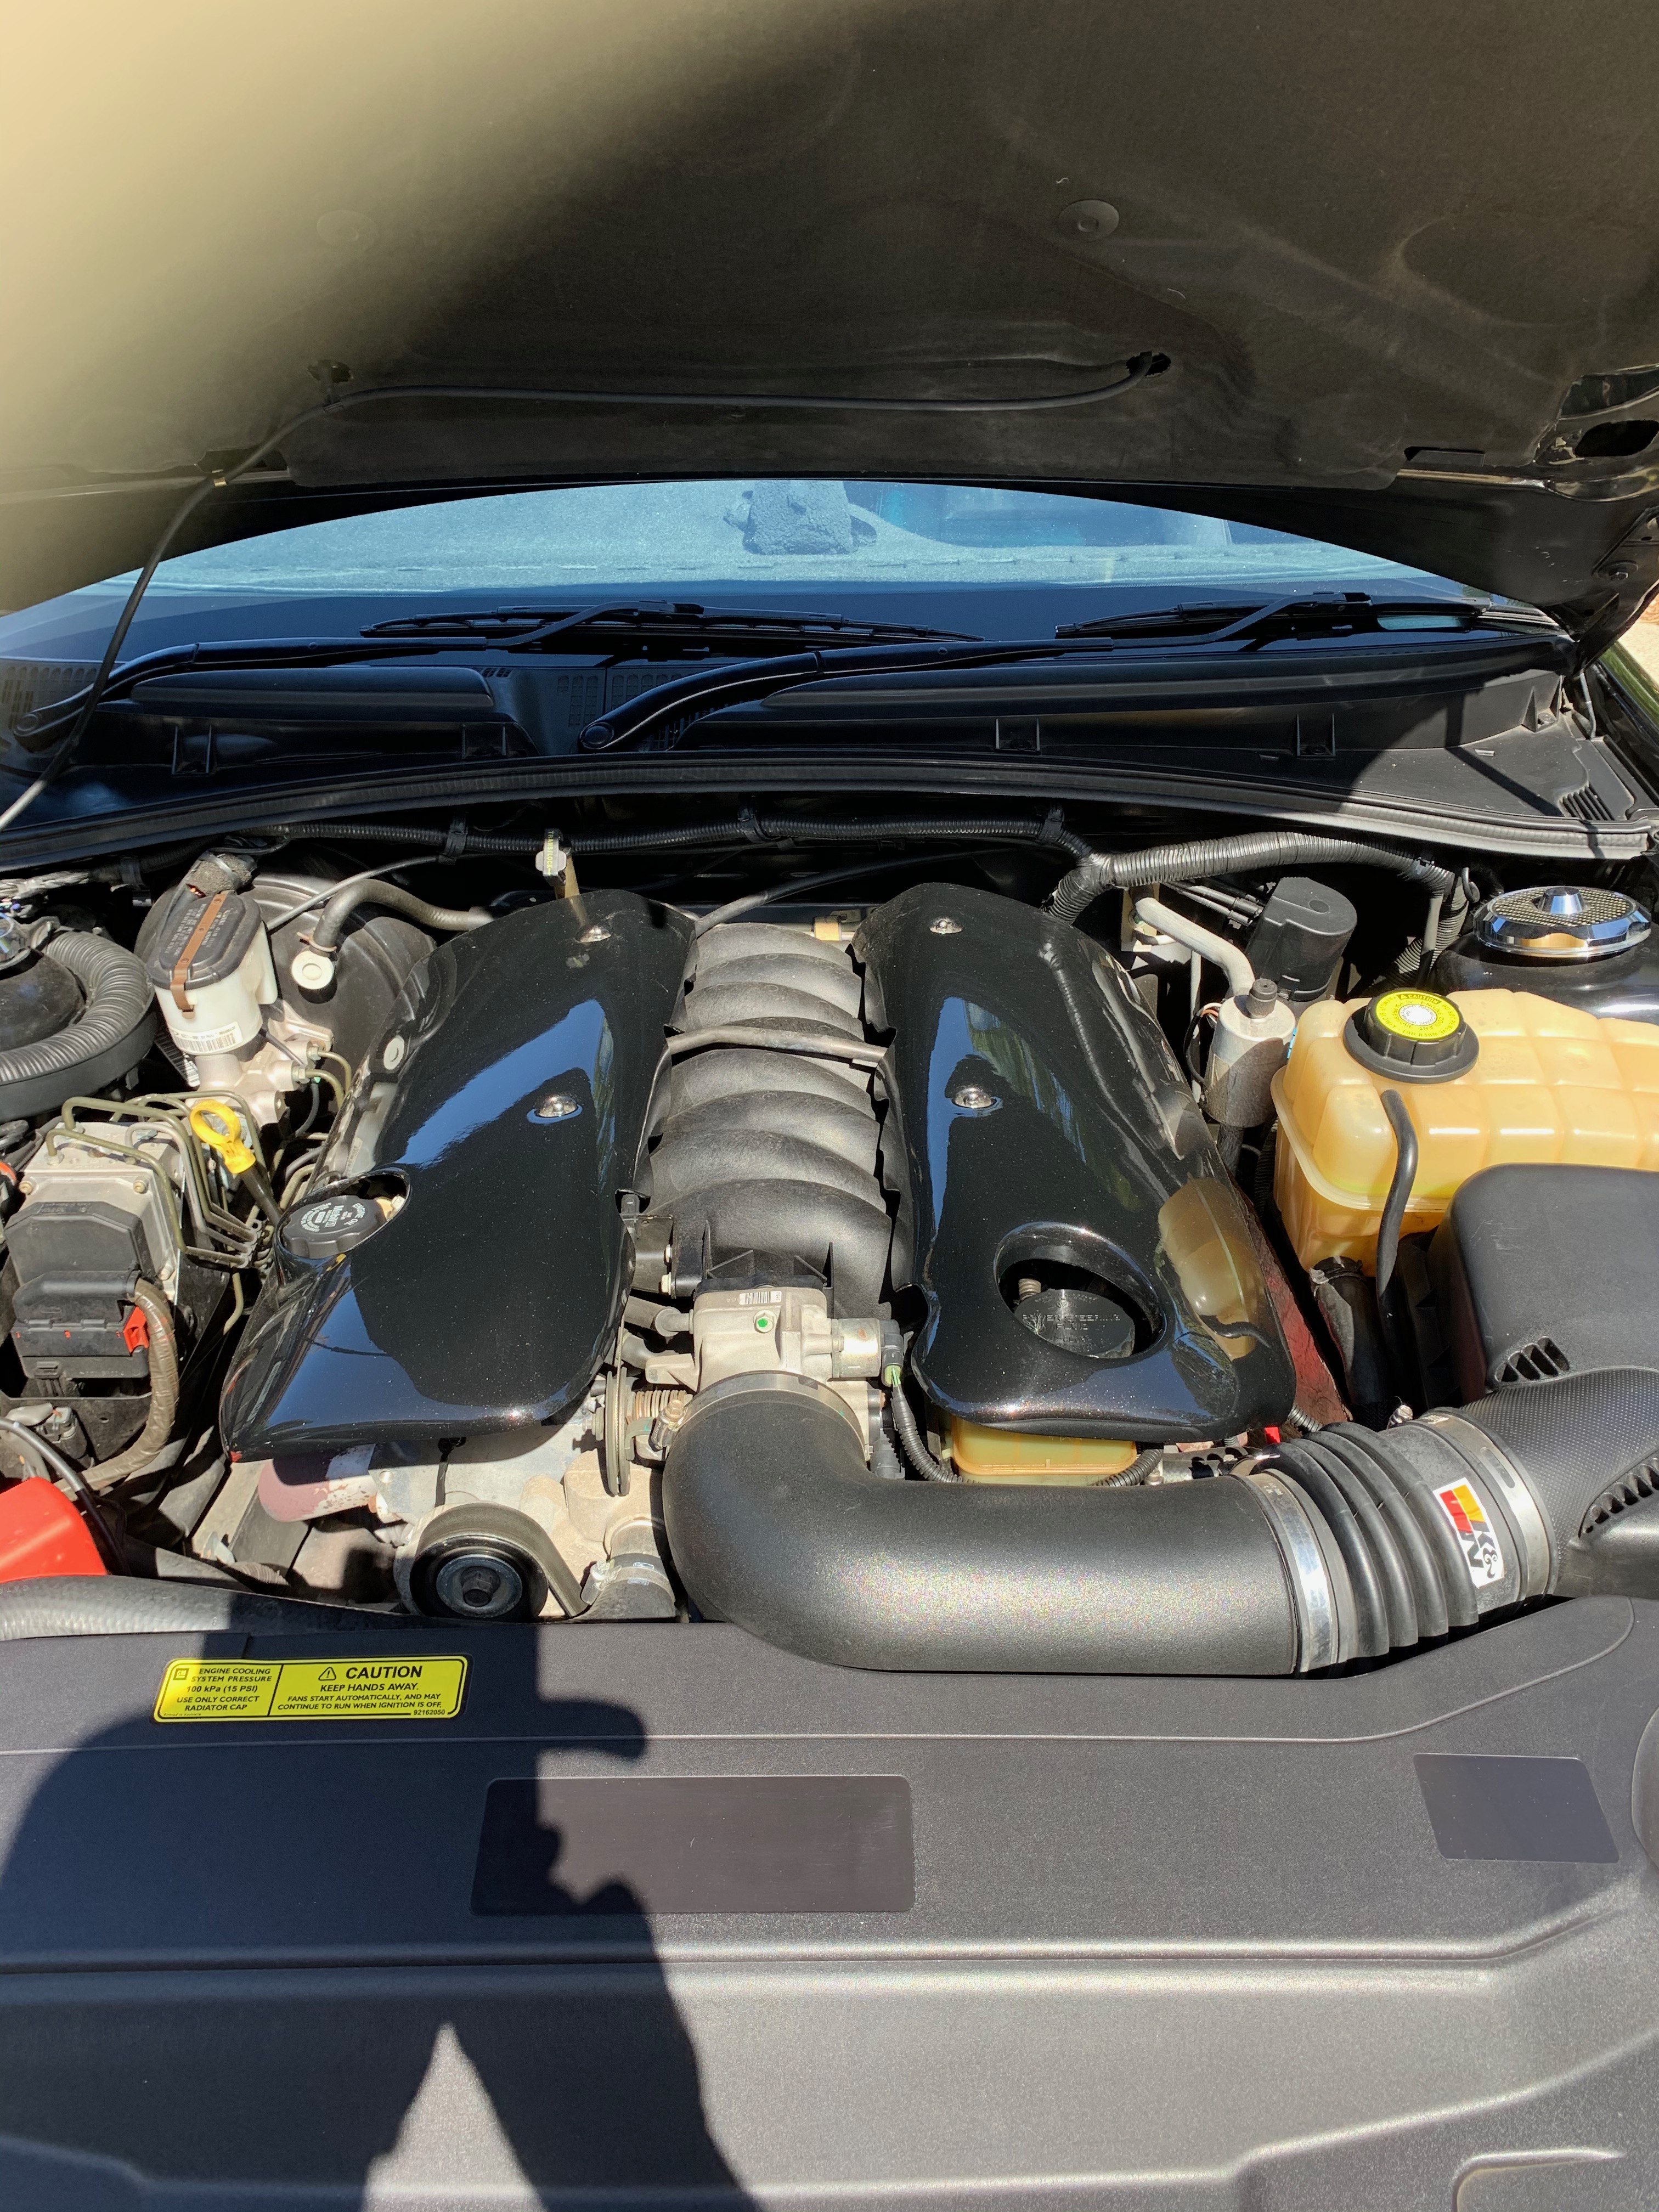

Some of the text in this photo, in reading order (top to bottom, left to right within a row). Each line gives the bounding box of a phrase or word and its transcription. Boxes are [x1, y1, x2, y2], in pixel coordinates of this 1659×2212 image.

[1408, 994, 1439, 1005] CAUTION
[1421, 1001, 1443, 1015] ENGINE
[1419, 1017, 1444, 1030] COOLANT
[328, 1205, 345, 1221] Mobil
[352, 1203, 366, 1218] ENGINE
[345, 1665, 423, 1679] CAUTION
[223, 1685, 238, 1694] (15
[239, 1685, 258, 1693] PSI)
[347, 1683, 385, 1691] HANDS
[387, 1683, 419, 1691] AWAY.
